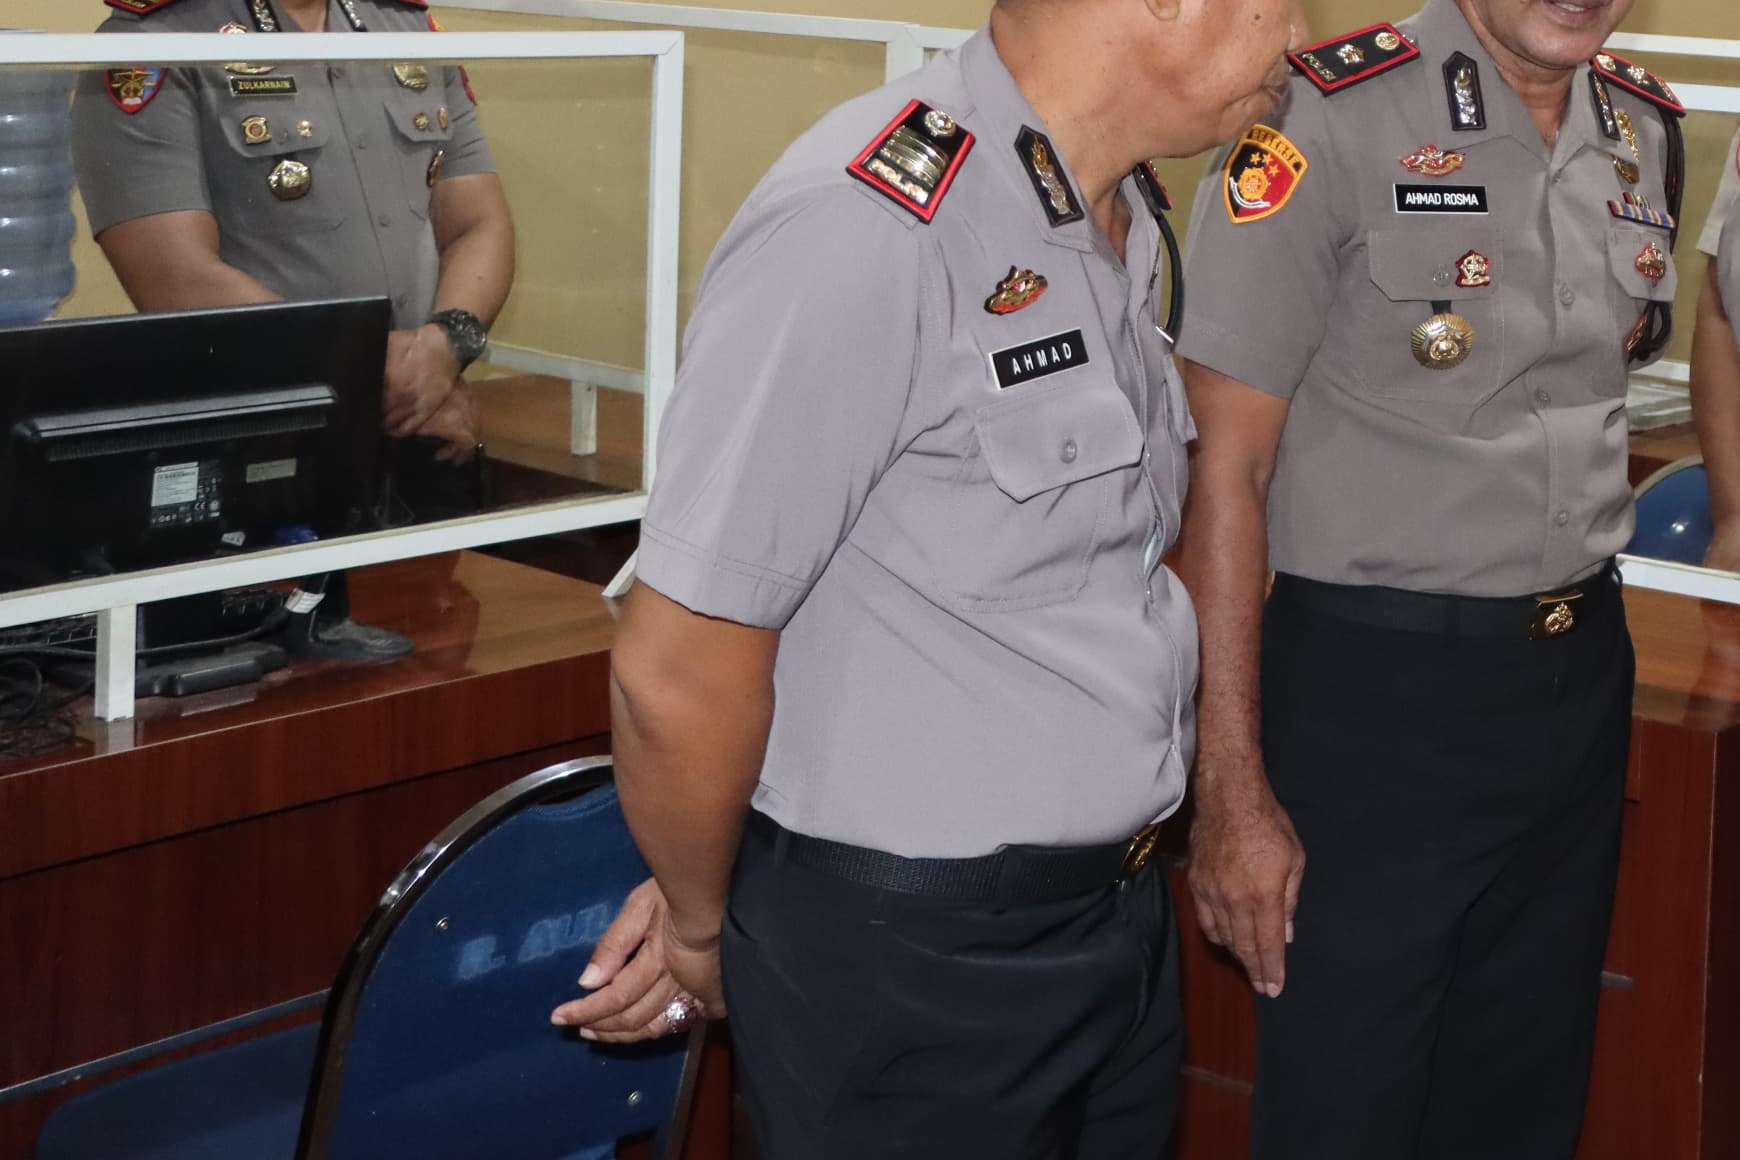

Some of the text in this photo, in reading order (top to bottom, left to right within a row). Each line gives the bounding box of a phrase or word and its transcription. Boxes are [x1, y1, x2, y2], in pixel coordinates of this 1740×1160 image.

[1405, 192, 1480, 206] AHMAD ROSMA
[1012, 342, 1072, 375] AHMAD
